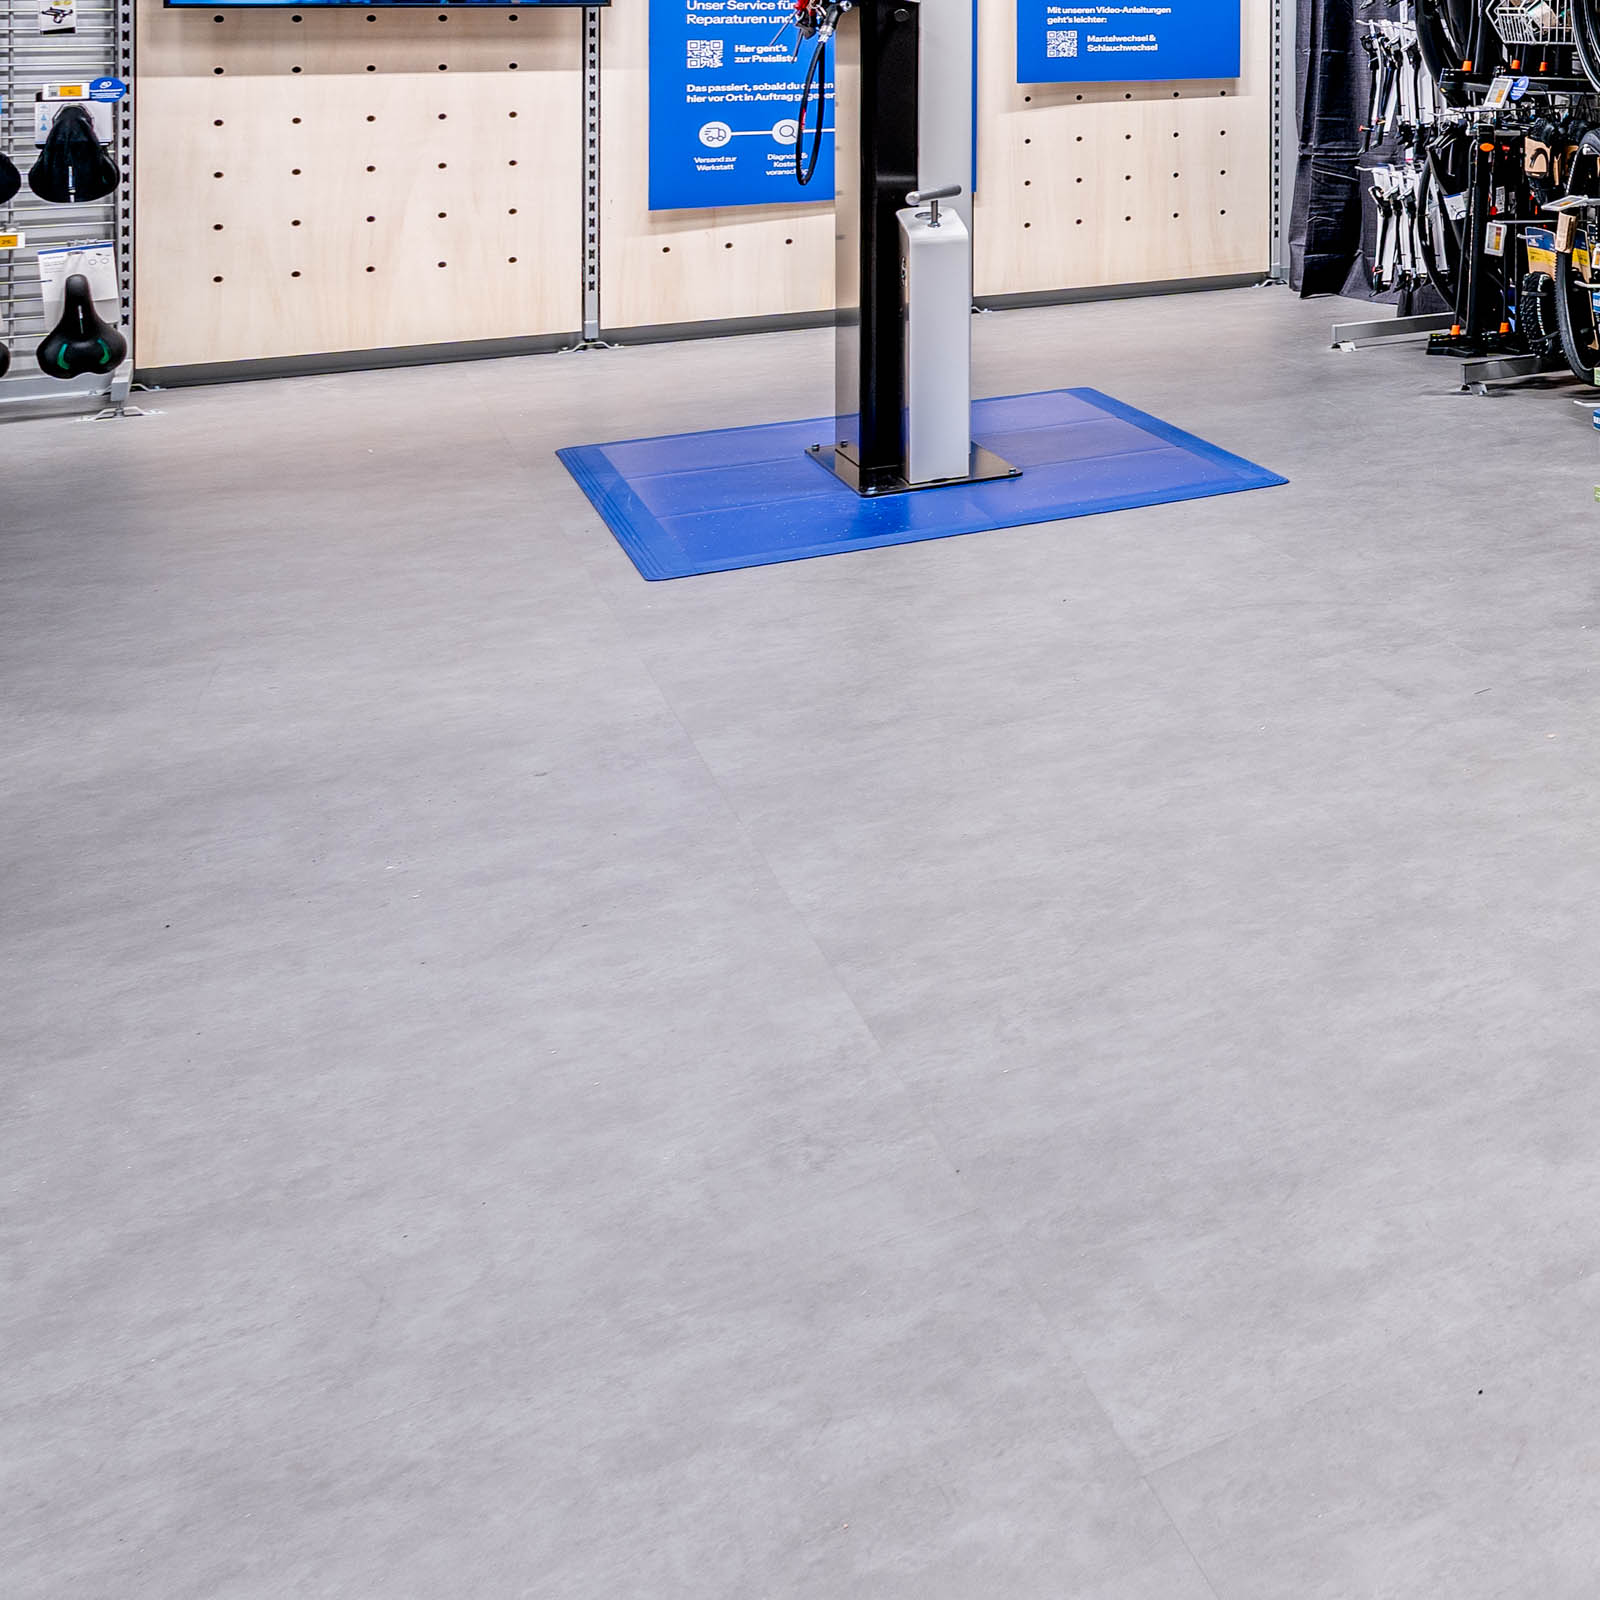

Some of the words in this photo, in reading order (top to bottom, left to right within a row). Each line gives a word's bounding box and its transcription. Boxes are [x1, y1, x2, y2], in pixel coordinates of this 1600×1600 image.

[687, 0, 726, 10] Unser
[727, 0, 776, 10] Service
[777, 0, 796, 10] für
[1047, 6, 1061, 14] Mit
[1096, 6, 1171, 15] Video-Anleitungen
[686, 14, 767, 26] Reparaturen
[768, 14, 794, 24] und
[1047, 16, 1073, 25] geht's
[1149, 34, 1156, 42] &
[734, 44, 755, 53] Hier
[1087, 44, 1158, 52] Schlauchwechsel
[686, 84, 707, 93] Das
[708, 83, 752, 94] passiert,
[752, 83, 787, 92] sobald
[787, 83, 800, 91] du
[686, 95, 707, 103] hier
[708, 95, 725, 103] vor
[725, 94, 744, 102] Ort
[744, 93, 754, 101] in
[754, 93, 794, 102] Auftrag
